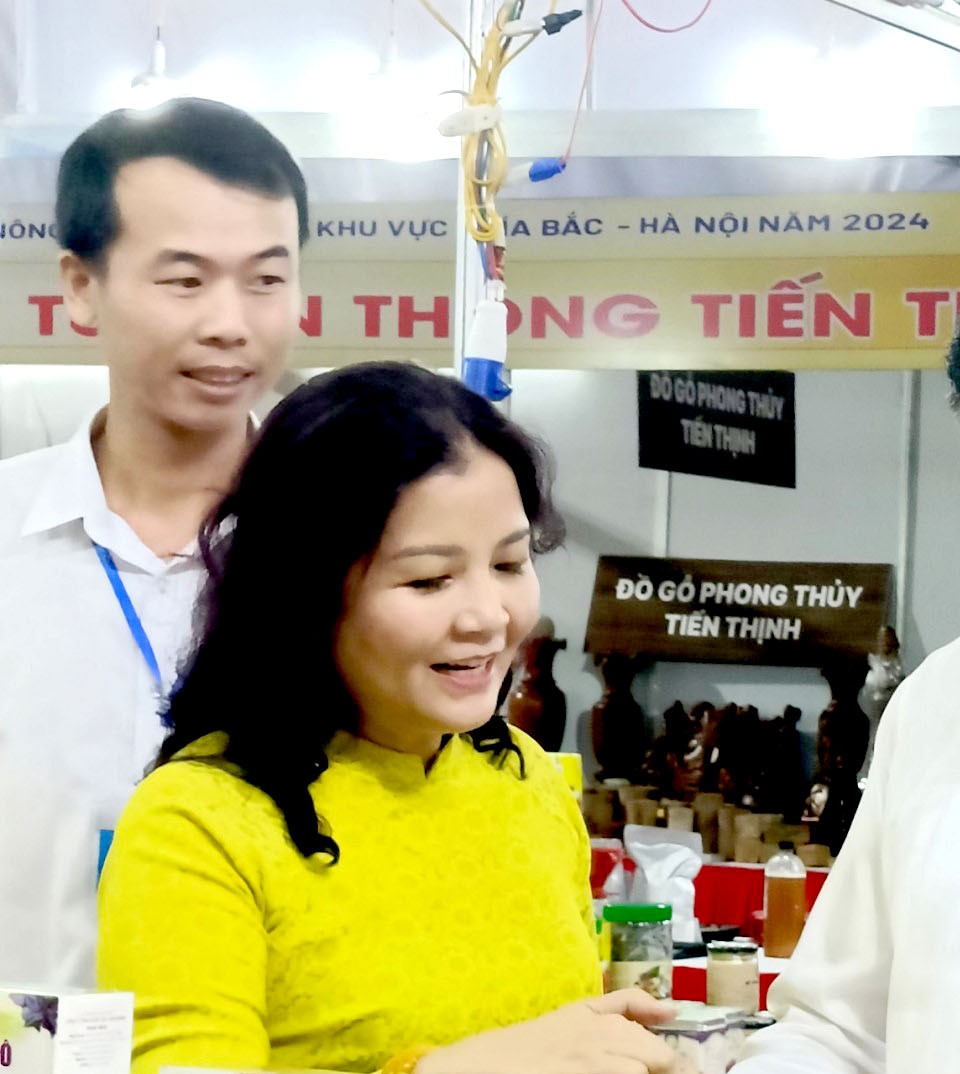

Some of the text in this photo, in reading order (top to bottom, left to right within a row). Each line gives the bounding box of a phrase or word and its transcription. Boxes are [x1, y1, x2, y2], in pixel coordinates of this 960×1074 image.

[316, 211, 930, 241] KHU VỰC BẮC HÀ NỘI NĂM 2024
[353, 294, 661, 338] THNG
[691, 271, 871, 338] TIẾN
[697, 381, 747, 415] PHONG
[700, 582, 788, 607] PHONG
[793, 577, 864, 609] THỦY
[725, 615, 802, 646] THỊNH
